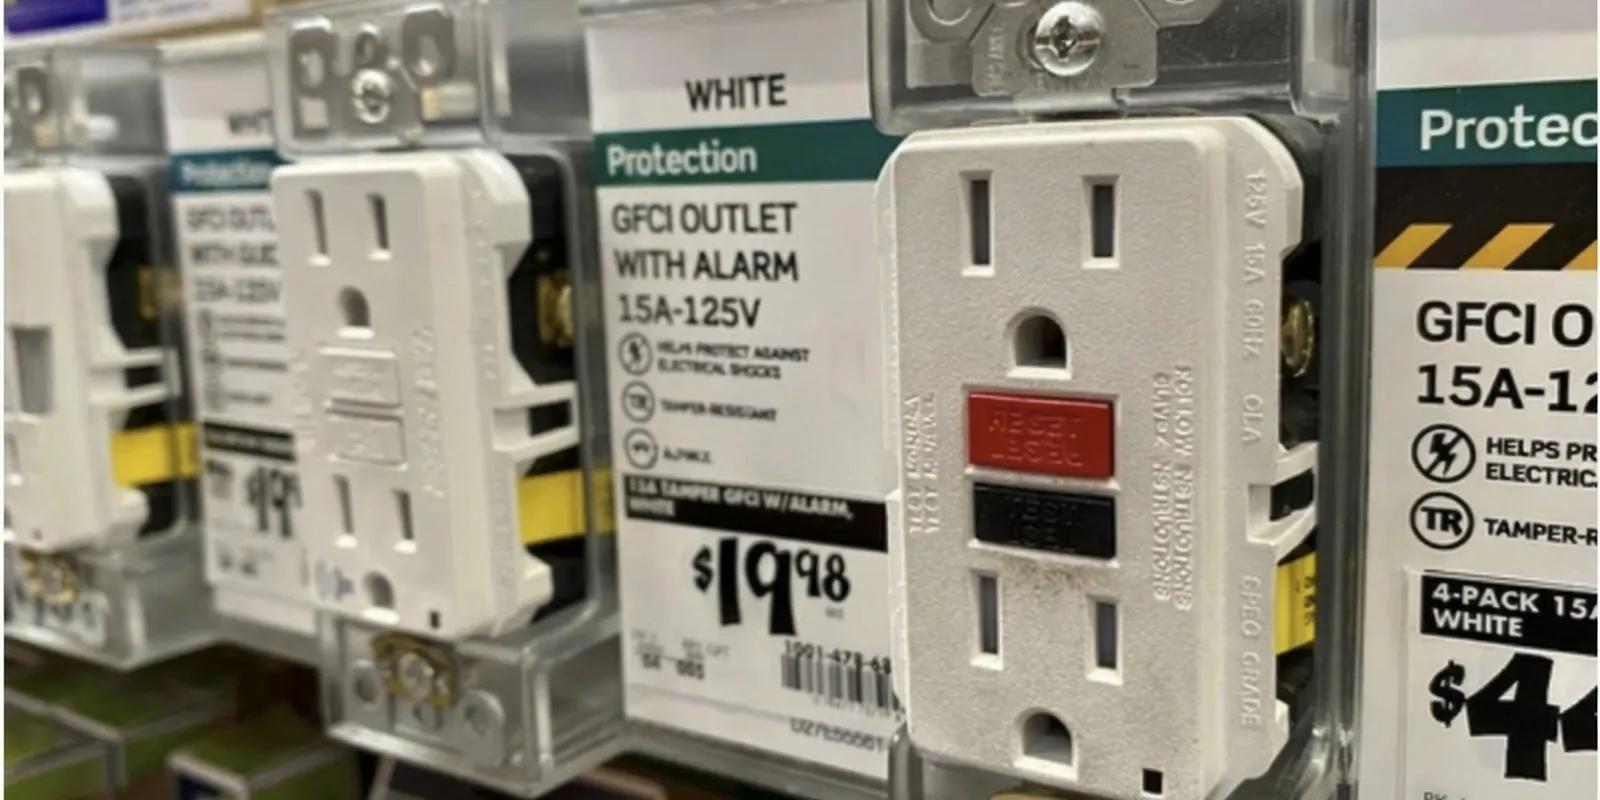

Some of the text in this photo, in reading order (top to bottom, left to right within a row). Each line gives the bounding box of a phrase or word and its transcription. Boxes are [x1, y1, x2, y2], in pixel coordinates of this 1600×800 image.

[685, 73, 788, 111] WHITE
[607, 140, 758, 176] Protection
[612, 202, 797, 233] GFCI OUTLET
[614, 249, 799, 281] WITH ALARM
[618, 295, 761, 328] 15A-125V
[1416, 300, 1594, 348] GFCI O
[1486, 437, 1560, 459] HELPS
[1485, 462, 1597, 488] ELECTRIC
[1420, 505, 1464, 537] TR
[1432, 582, 1539, 613] 4-PACK
[1432, 607, 1523, 638] WHITE
